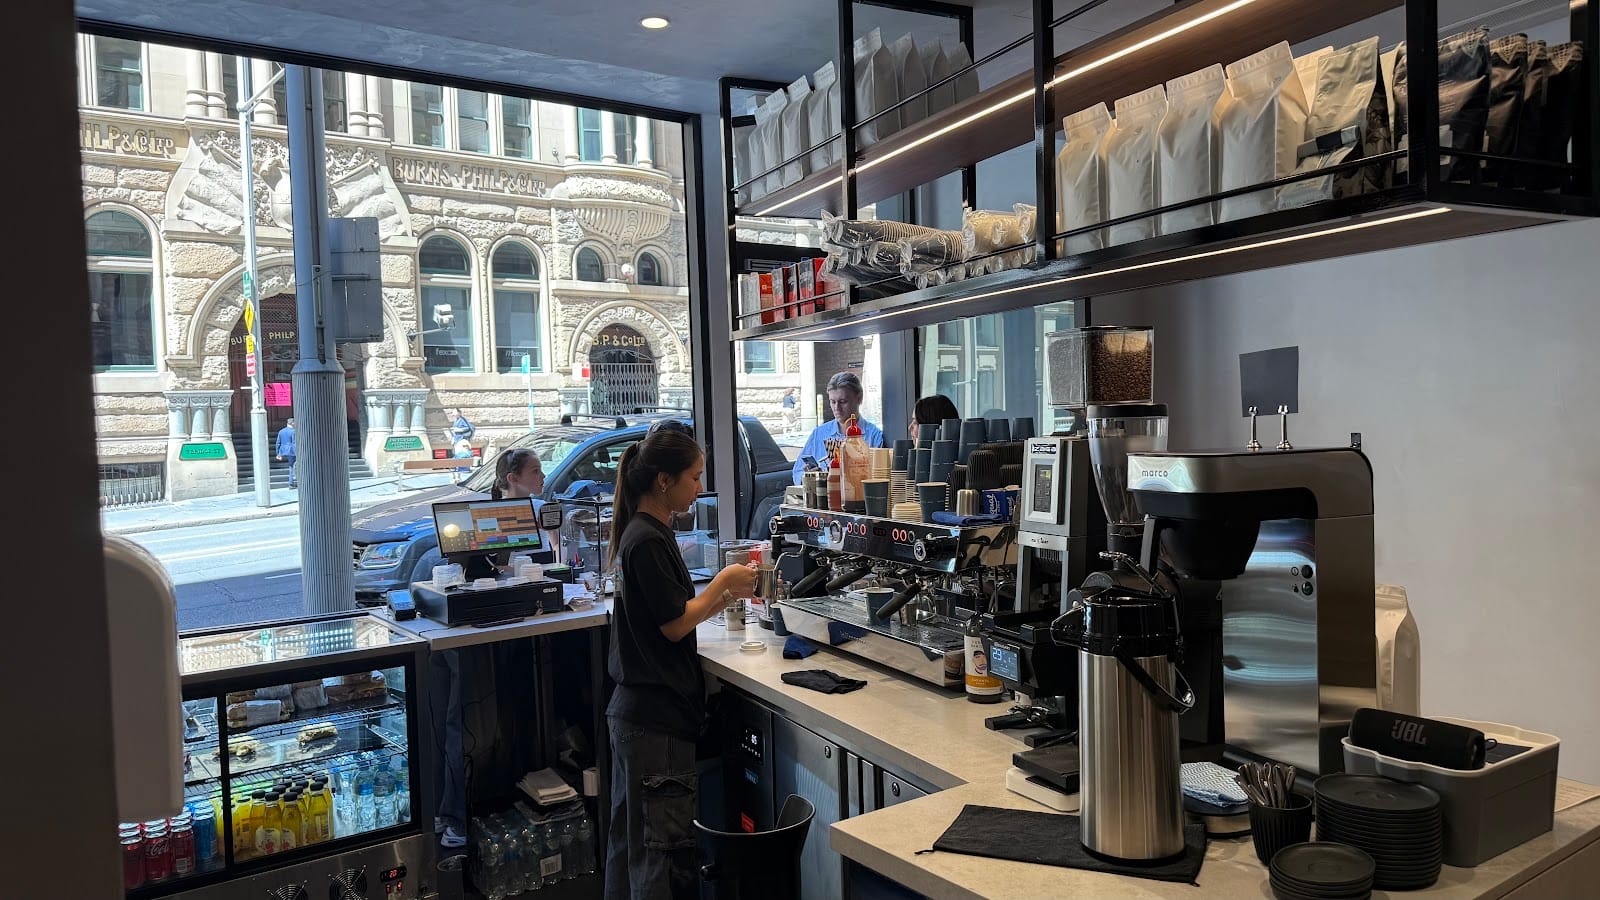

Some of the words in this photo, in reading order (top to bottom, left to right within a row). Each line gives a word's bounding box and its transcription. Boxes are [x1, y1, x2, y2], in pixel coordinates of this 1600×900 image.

[461, 165, 507, 192] PHILP
[268, 331, 295, 340] PHILP
[612, 335, 620, 346] &
[1141, 470, 1168, 478] marco
[1391, 720, 1427, 745] JBL
